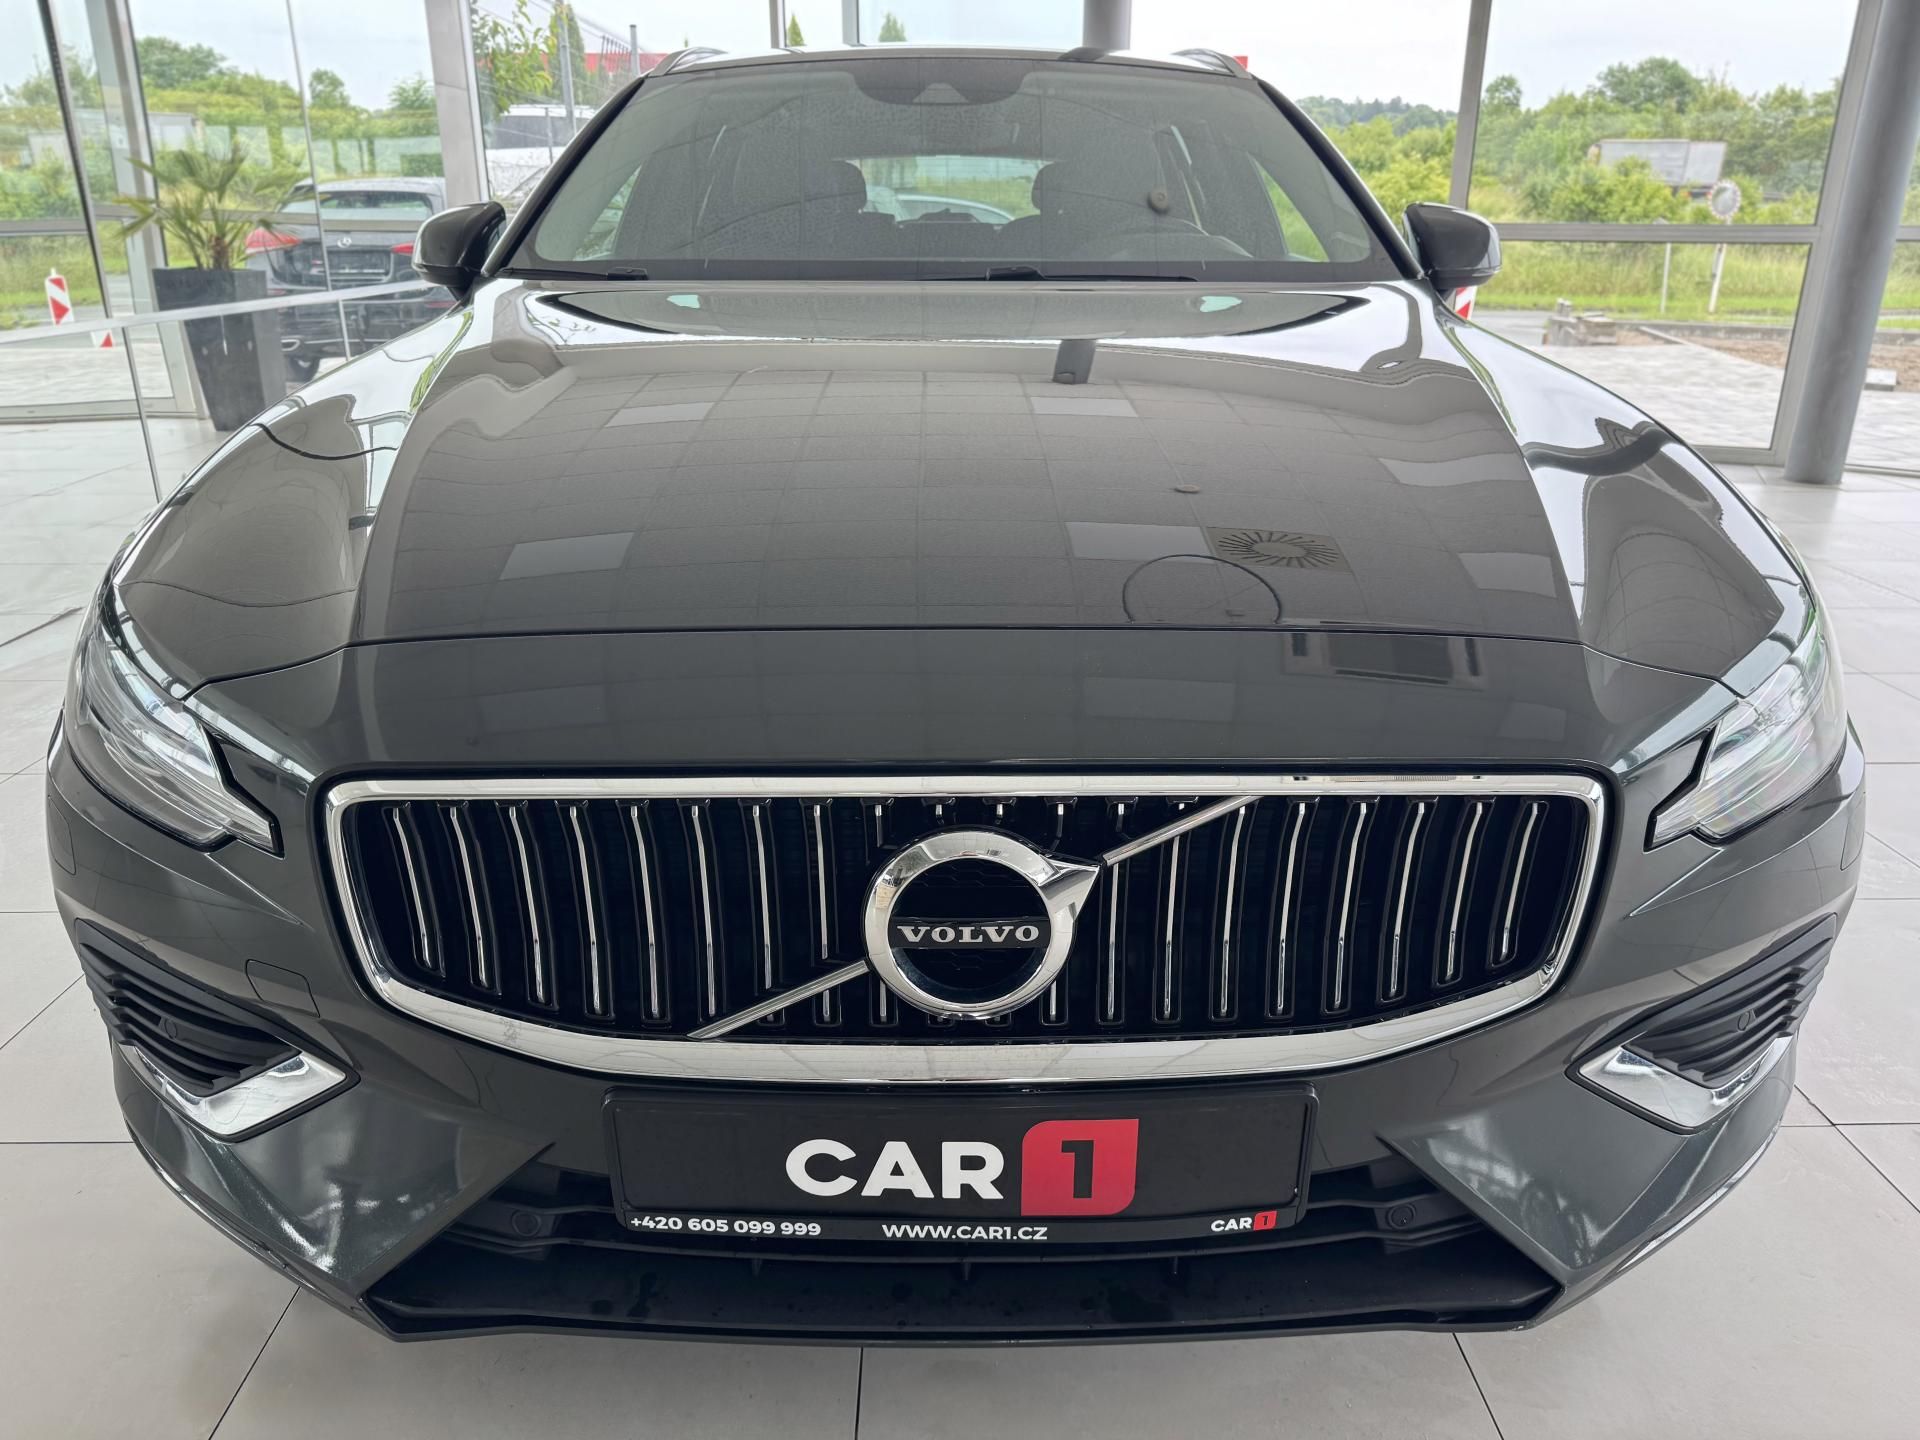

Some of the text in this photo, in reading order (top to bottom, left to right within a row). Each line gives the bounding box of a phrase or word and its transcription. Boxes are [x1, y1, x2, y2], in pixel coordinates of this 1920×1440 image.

[897, 925, 1039, 943] VOLVO
[785, 1138, 1095, 1200] CAR 1
[631, 1216, 821, 1236] +420 605 099 999
[881, 1224, 1048, 1240] WWW.CAR1.CZ
[1210, 1217, 1253, 1232] CAR
